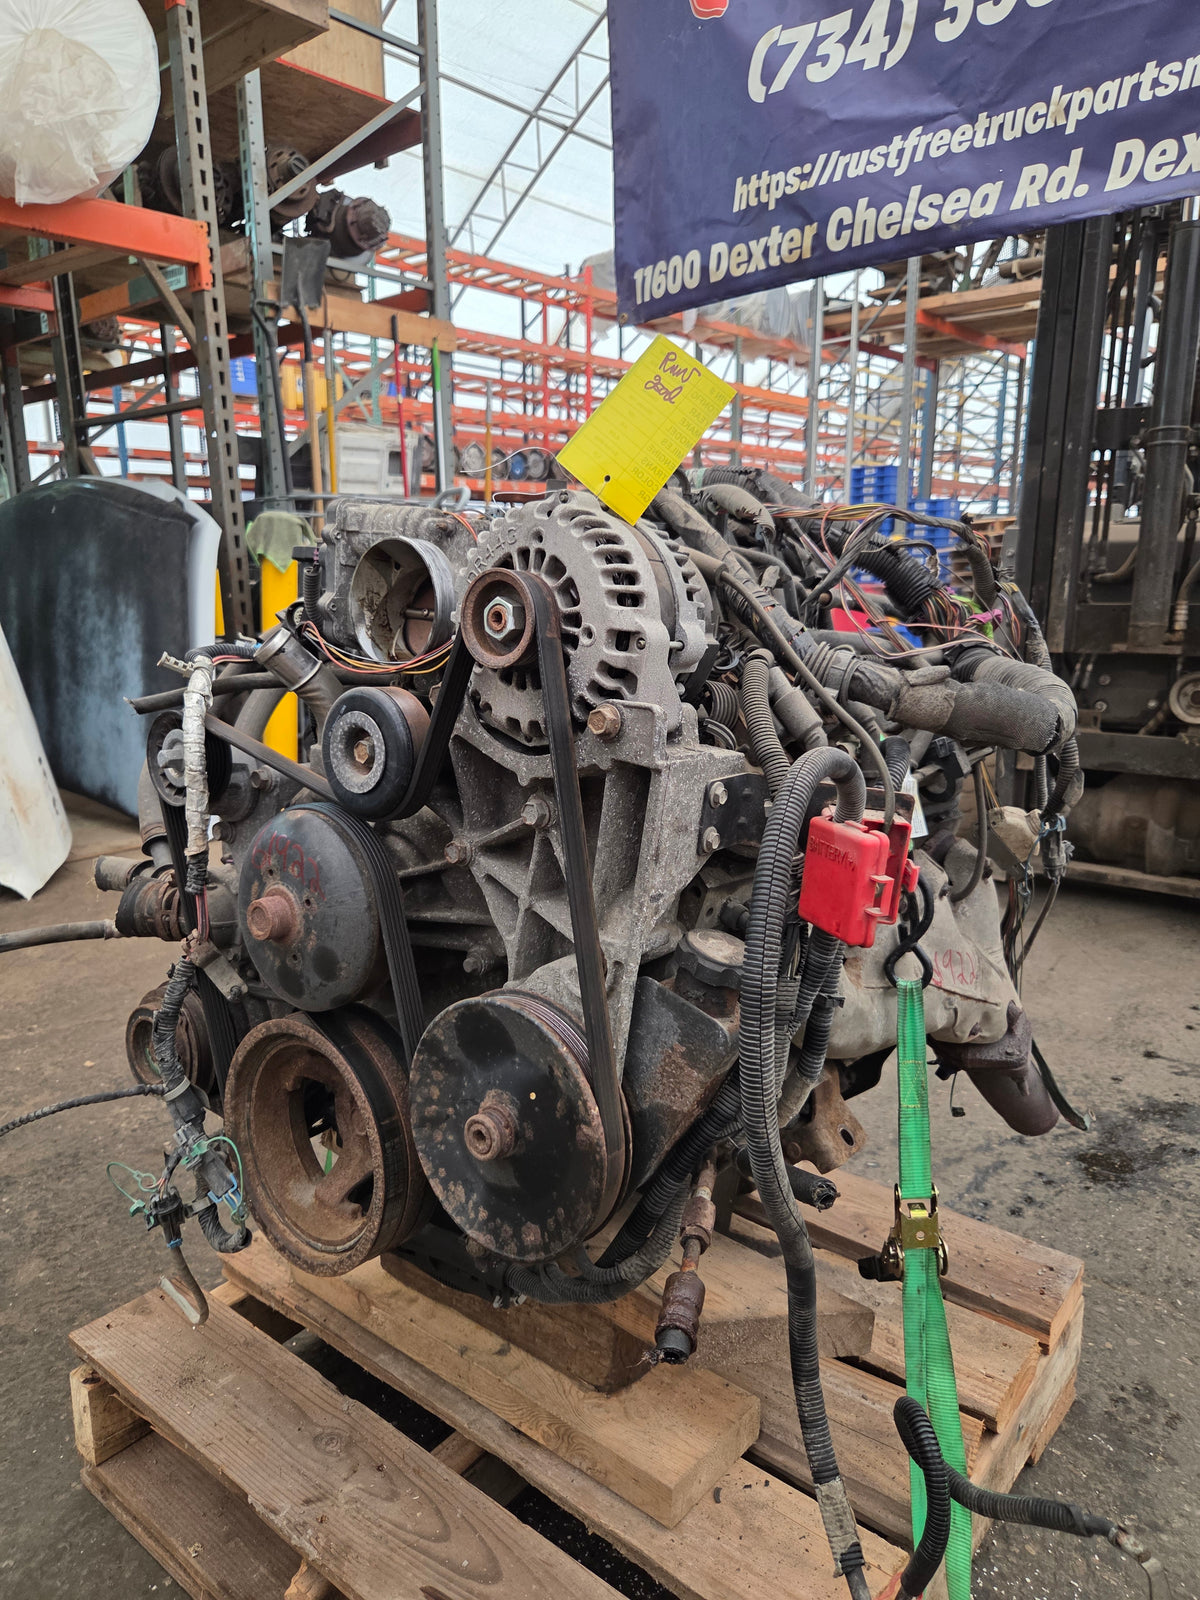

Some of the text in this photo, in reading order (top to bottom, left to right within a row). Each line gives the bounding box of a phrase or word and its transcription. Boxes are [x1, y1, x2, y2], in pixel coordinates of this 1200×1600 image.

[748, 0, 918, 103] (734)
[633, 249, 701, 305] 11600
[708, 222, 818, 284] Dexter
[826, 180, 1004, 252] Chelsea
[1009, 147, 1090, 211] Rd.
